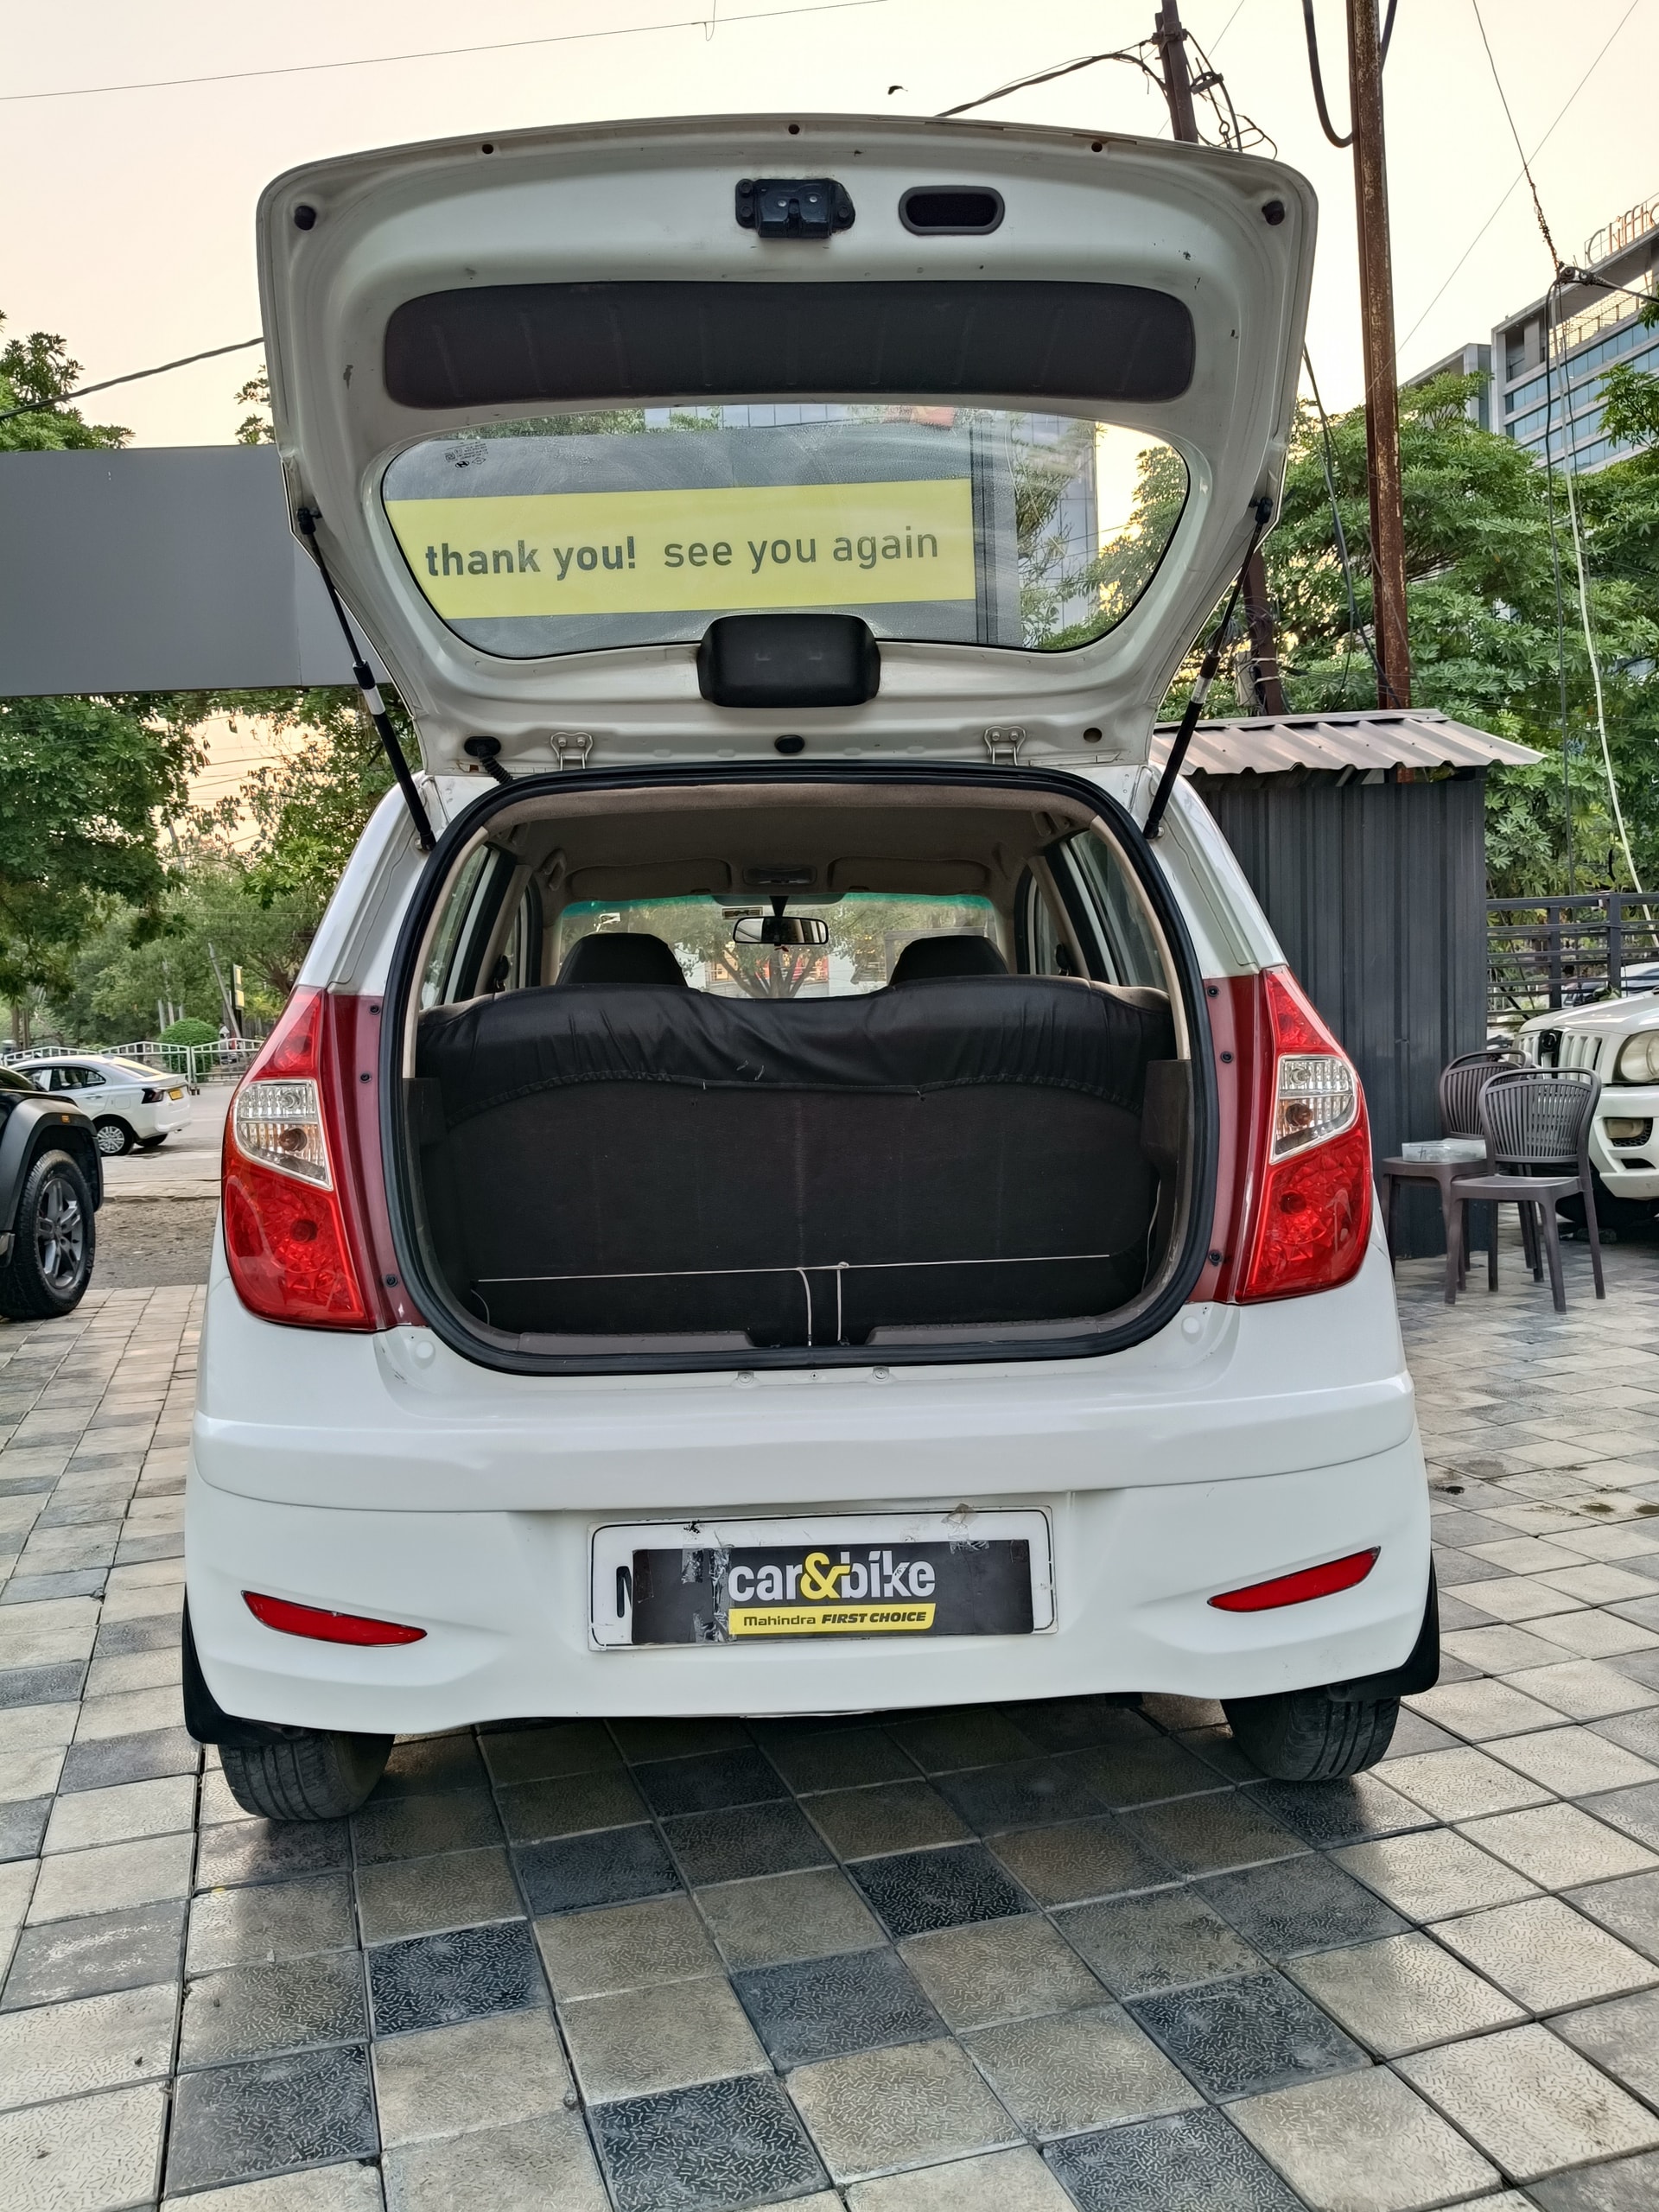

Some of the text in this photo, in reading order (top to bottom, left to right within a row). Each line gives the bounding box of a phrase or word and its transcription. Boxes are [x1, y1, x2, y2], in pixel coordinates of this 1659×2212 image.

[425, 525, 938, 581] thank you! see you again
[728, 1550, 936, 1602] car&bike
[743, 1611, 926, 1626] Mahindra FIRST CHOICE
